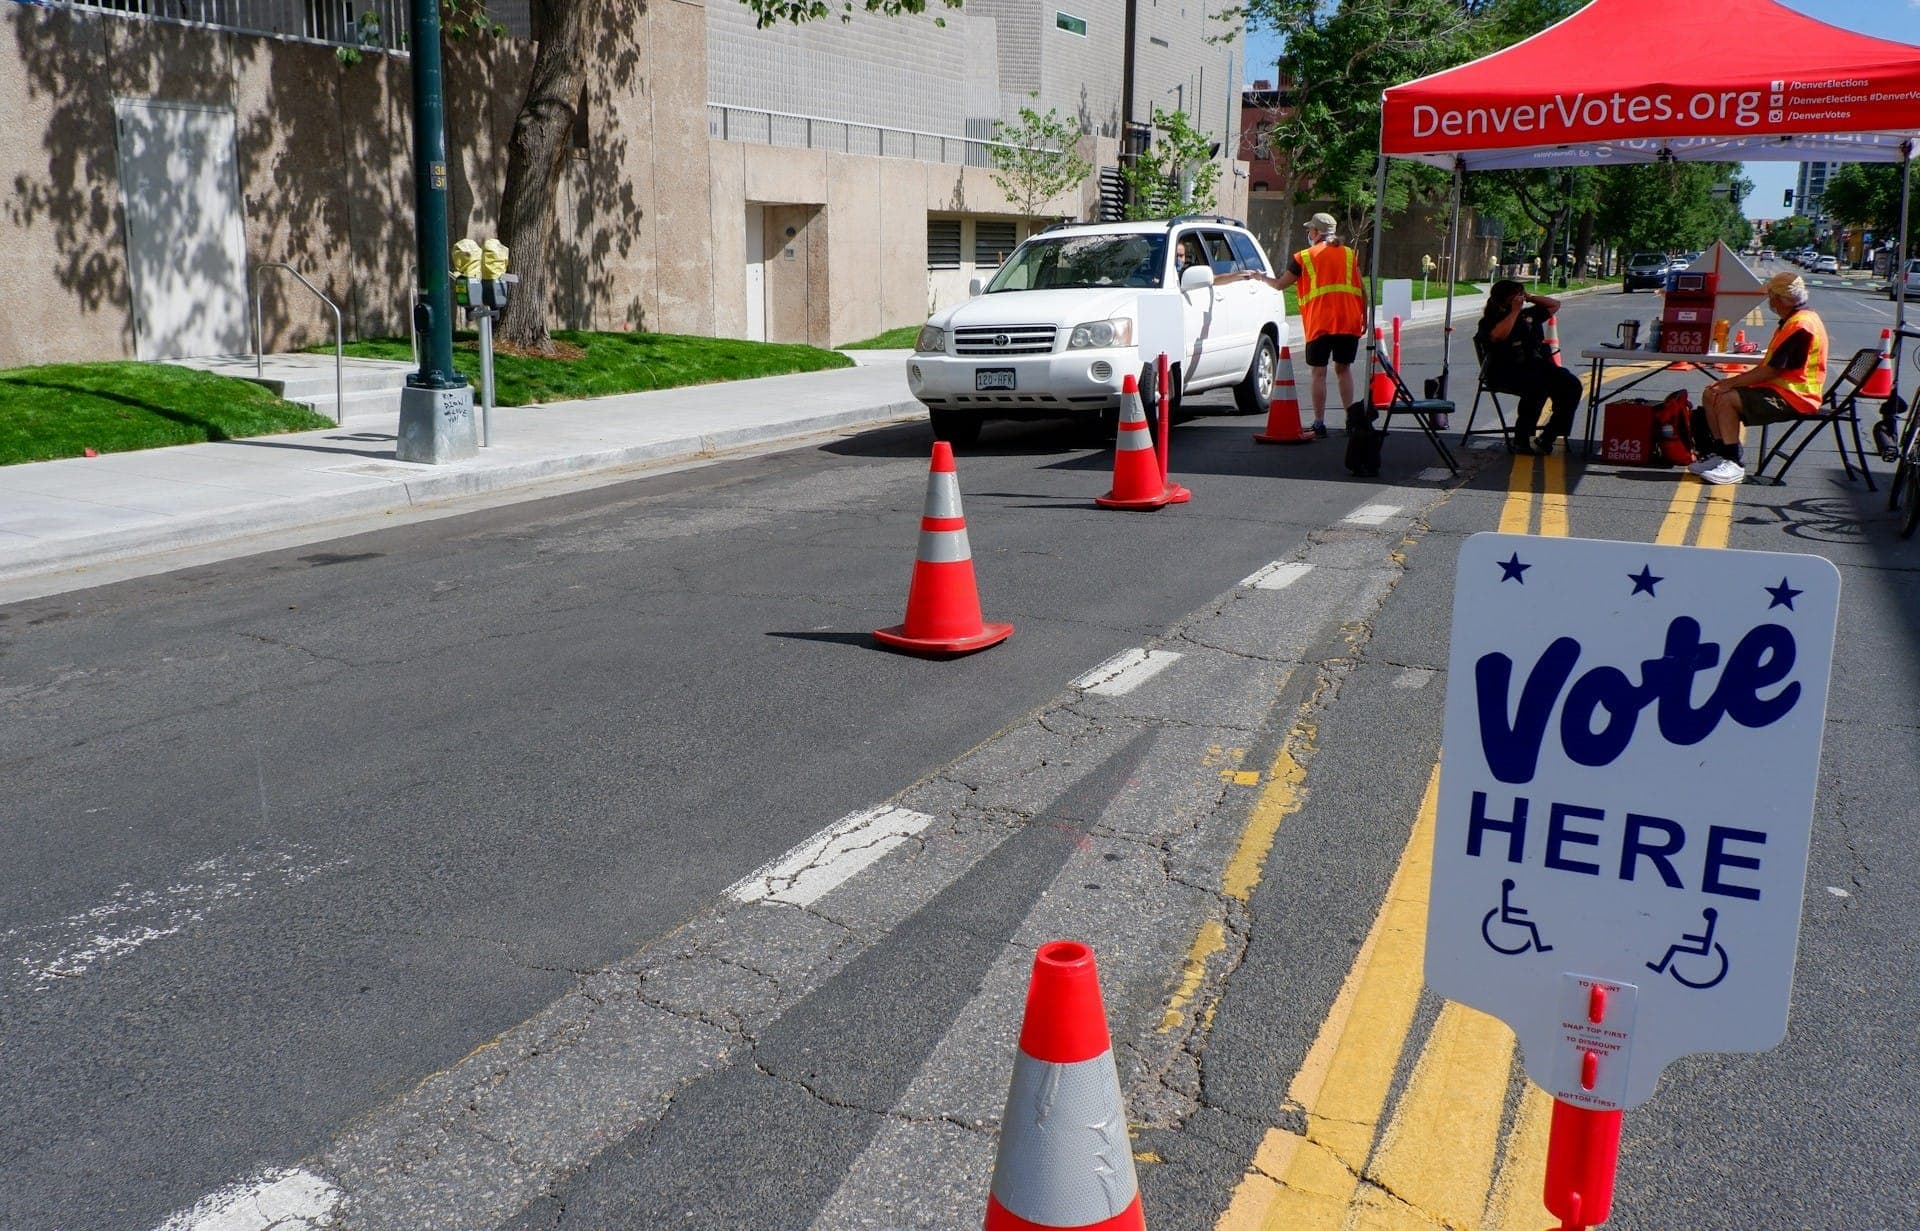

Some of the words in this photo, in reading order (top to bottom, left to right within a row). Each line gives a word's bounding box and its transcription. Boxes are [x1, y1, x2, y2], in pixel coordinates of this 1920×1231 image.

[1789, 79, 1869, 91] /DenverElections
[1788, 94, 1868, 106] /DenverElections
[1412, 91, 1762, 137] DenverVotes.org
[1787, 111, 1851, 121] /DenverVotes
[1667, 331, 1702, 345] 363
[1666, 345, 1702, 353] DENVER
[1610, 438, 1641, 453] 343
[1608, 452, 1641, 461] DENVER
[1475, 615, 1802, 784] Vote
[1466, 790, 1767, 900] HERE
[1578, 980, 1589, 988] TO
[1562, 1022, 1584, 1031] SNAP
[1586, 1026, 1602, 1034] TOP
[1604, 1030, 1629, 1039] FIRST
[1578, 1038, 1622, 1051] DISMOUNT
[1558, 1091, 1591, 1103] BOTTOM
[1593, 1099, 1617, 1108] FIRST
